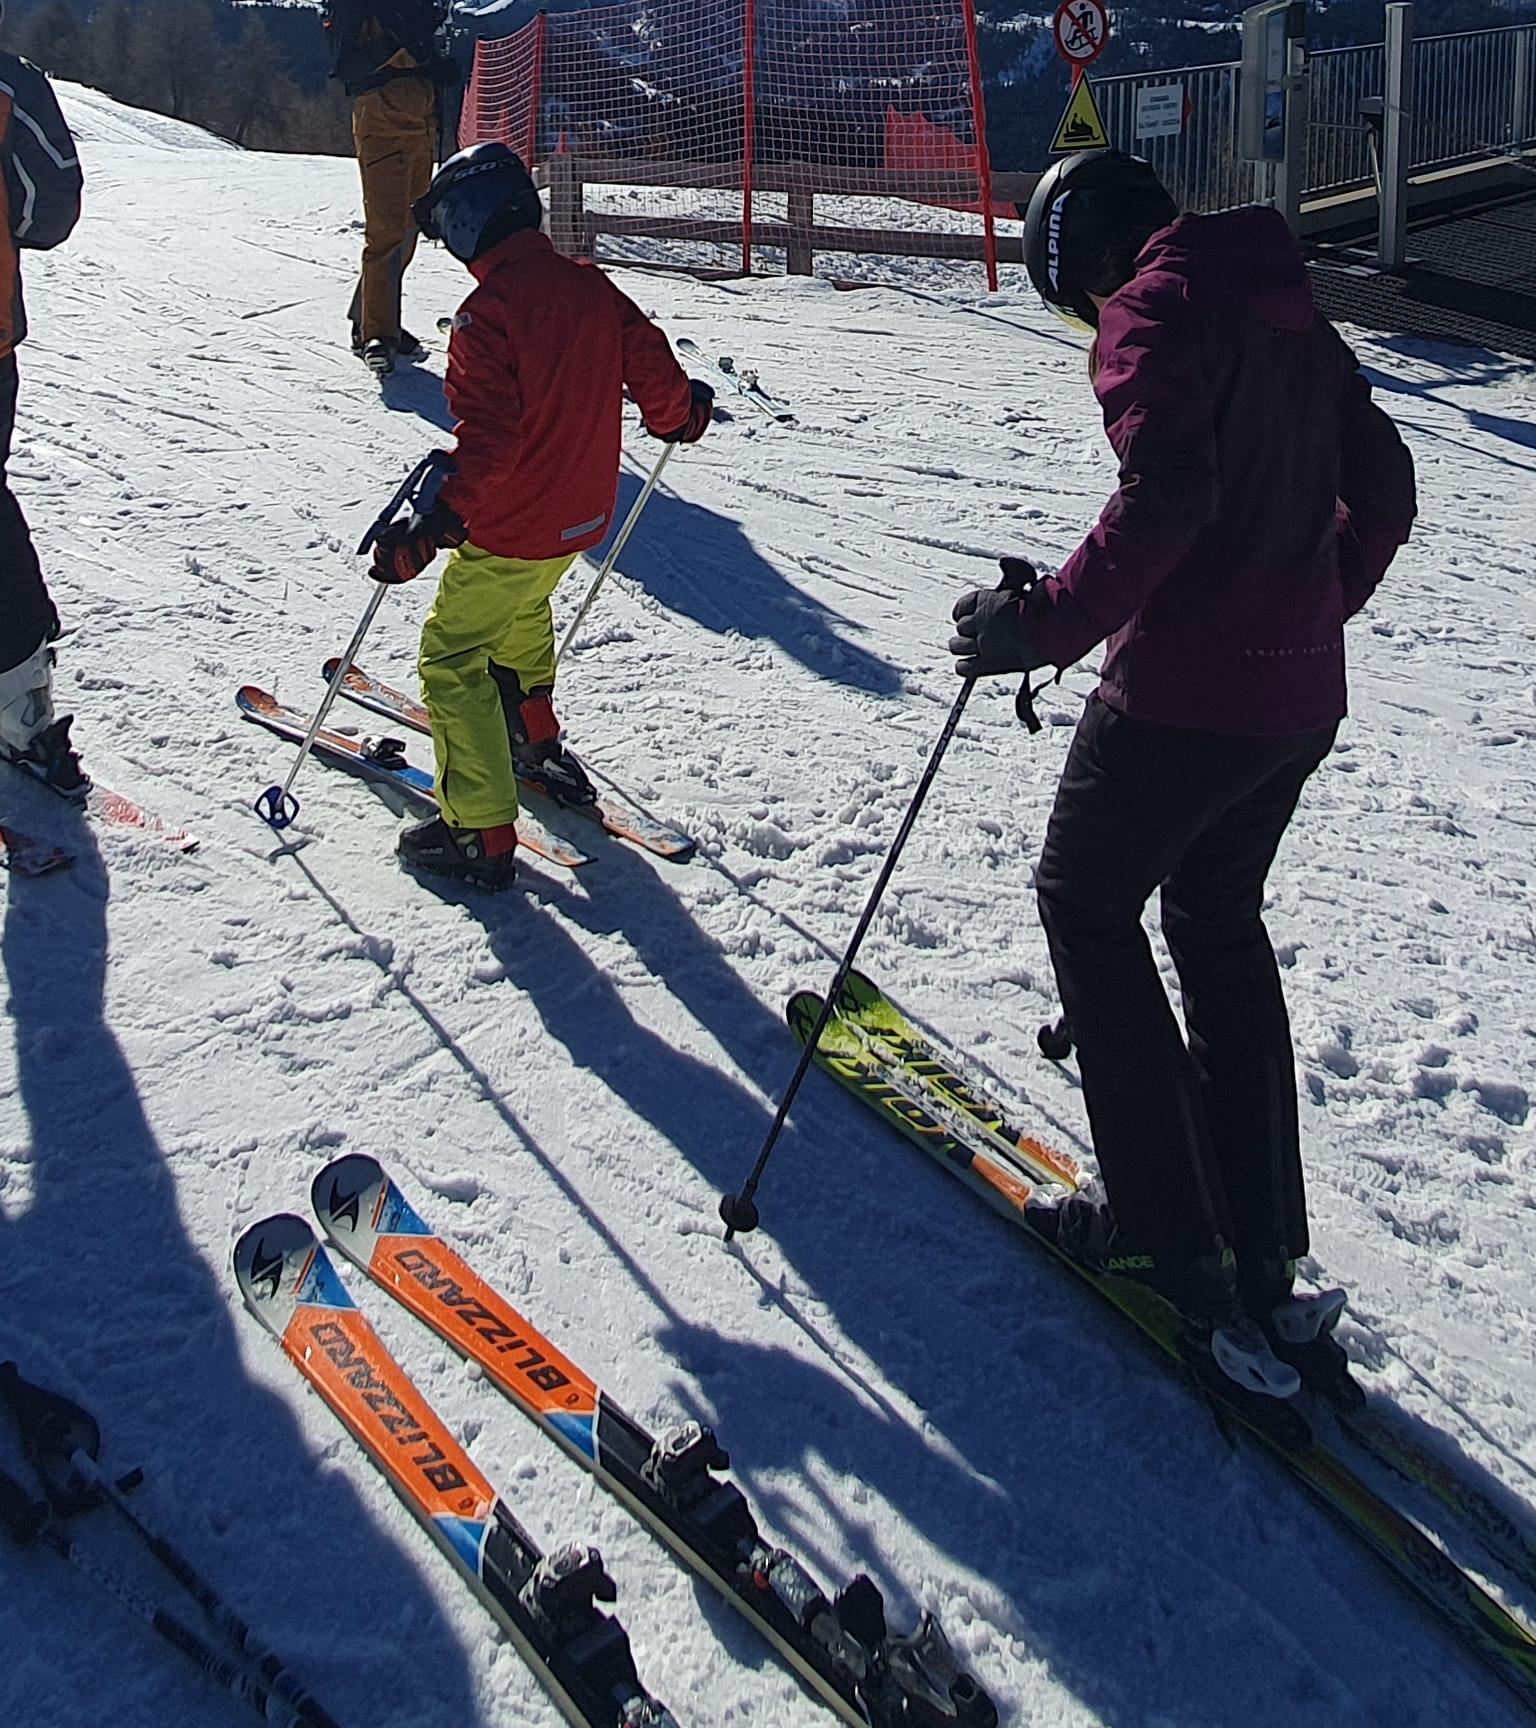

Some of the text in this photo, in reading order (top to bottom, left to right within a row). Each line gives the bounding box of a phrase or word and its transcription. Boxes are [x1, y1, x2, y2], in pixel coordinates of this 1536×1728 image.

[1048, 189, 1073, 293] ALPINA
[395, 1249, 572, 1392] BLIZZARD
[310, 1322, 468, 1492] BLIZZARD
